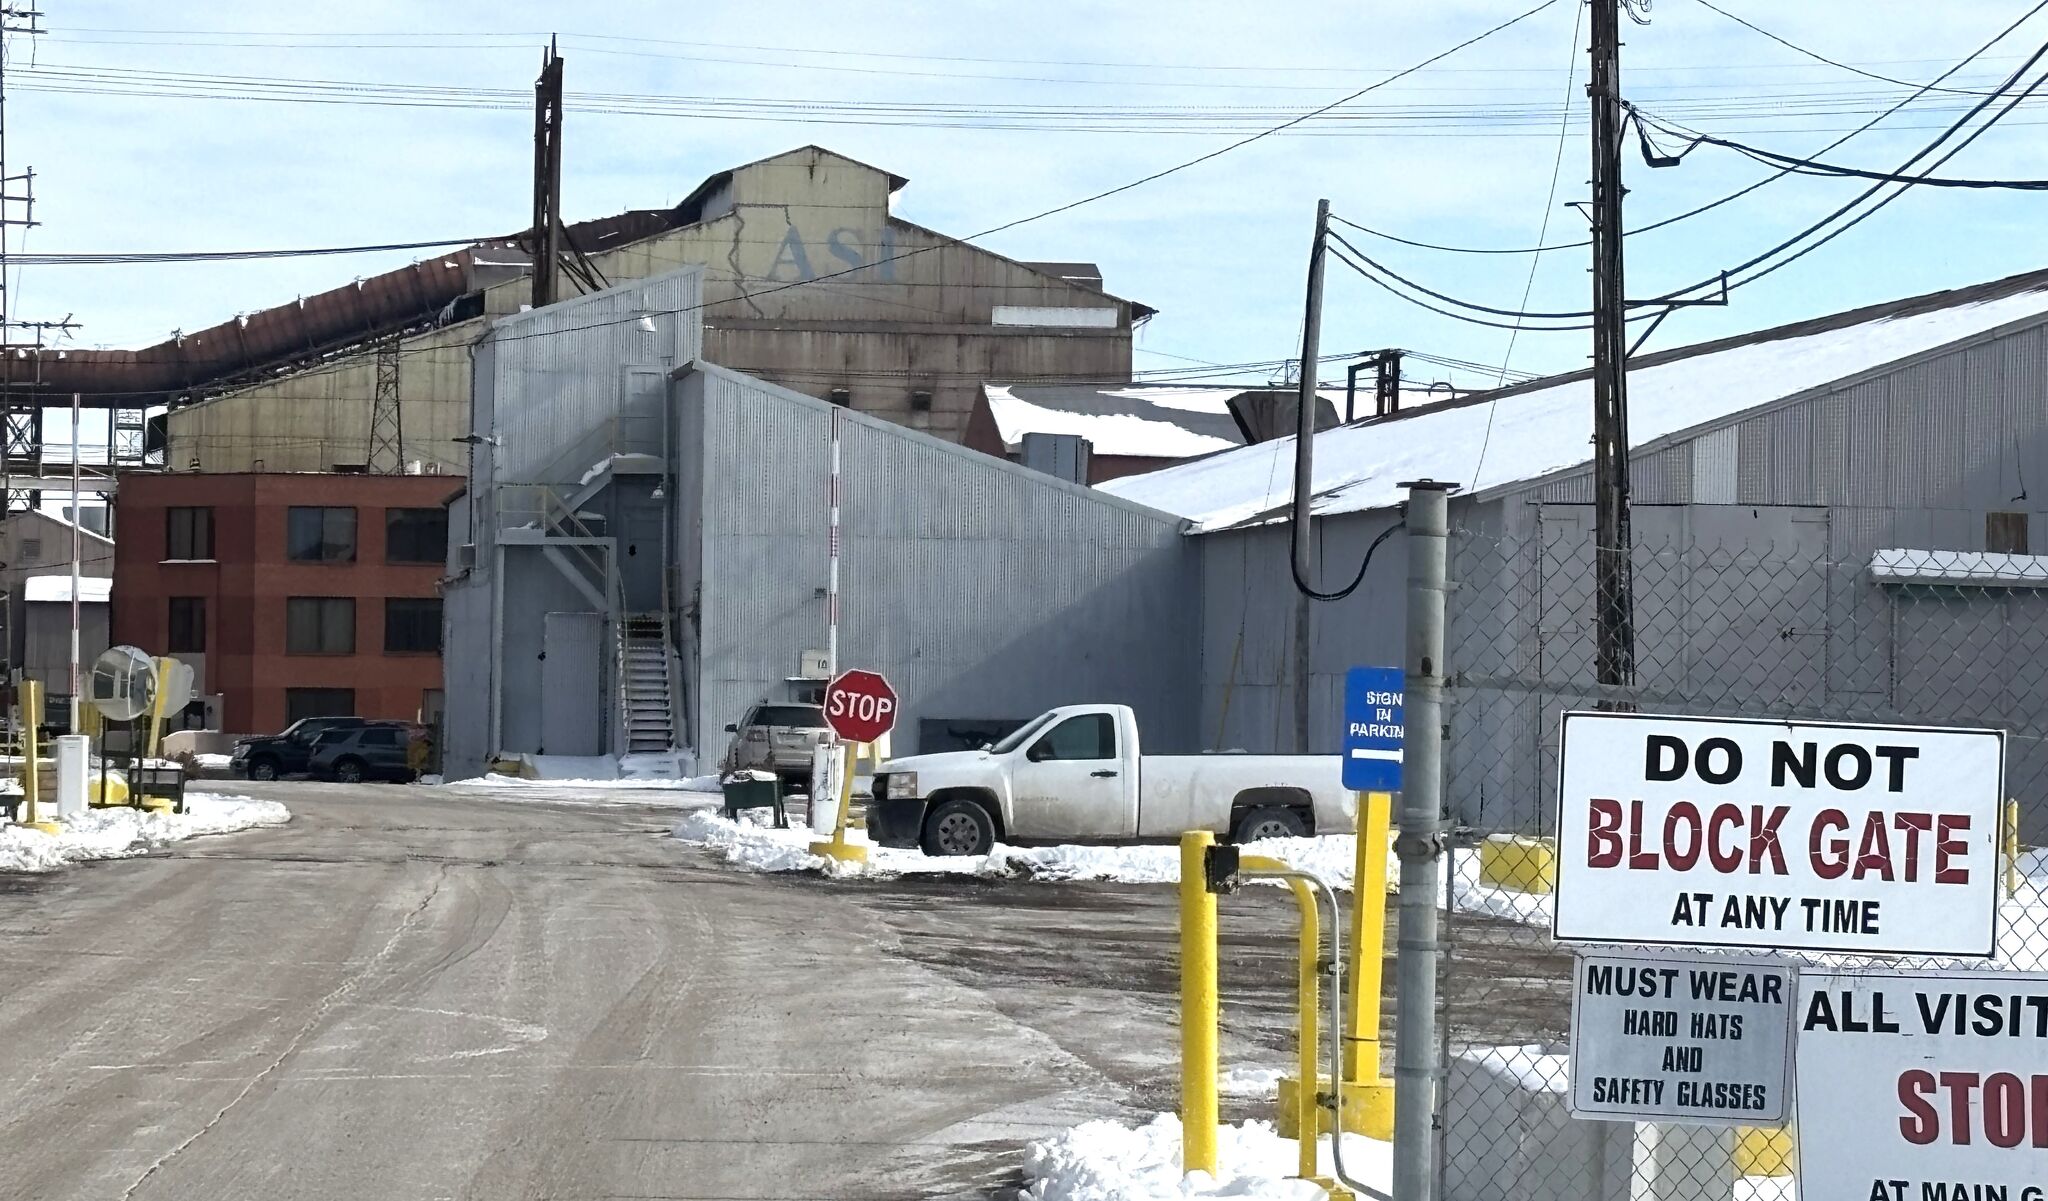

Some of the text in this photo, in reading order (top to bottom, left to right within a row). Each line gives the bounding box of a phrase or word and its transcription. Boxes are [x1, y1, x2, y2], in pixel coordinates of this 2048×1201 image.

[766, 224, 896, 284] ASI
[829, 689, 892, 723] STOP
[1366, 691, 1403, 706] SIGN
[1376, 708, 1392, 722] IN
[1350, 722, 1404, 738] PARKIN
[1646, 735, 1919, 792] DO NOT
[1588, 799, 1971, 885] BLOCK GATE
[1672, 893, 1879, 934] AT ANY TIME
[1588, 965, 1782, 1004] MUST WEAR
[1624, 1009, 1743, 1040] HARD HATS
[1803, 991, 2048, 1037] ALL VISIT
[1662, 1046, 1702, 1072] AND
[1594, 1077, 1766, 1110] SAFETY GLASSES
[1870, 1179, 1909, 1201] AT
[1922, 1182, 2007, 1201] MAIN
